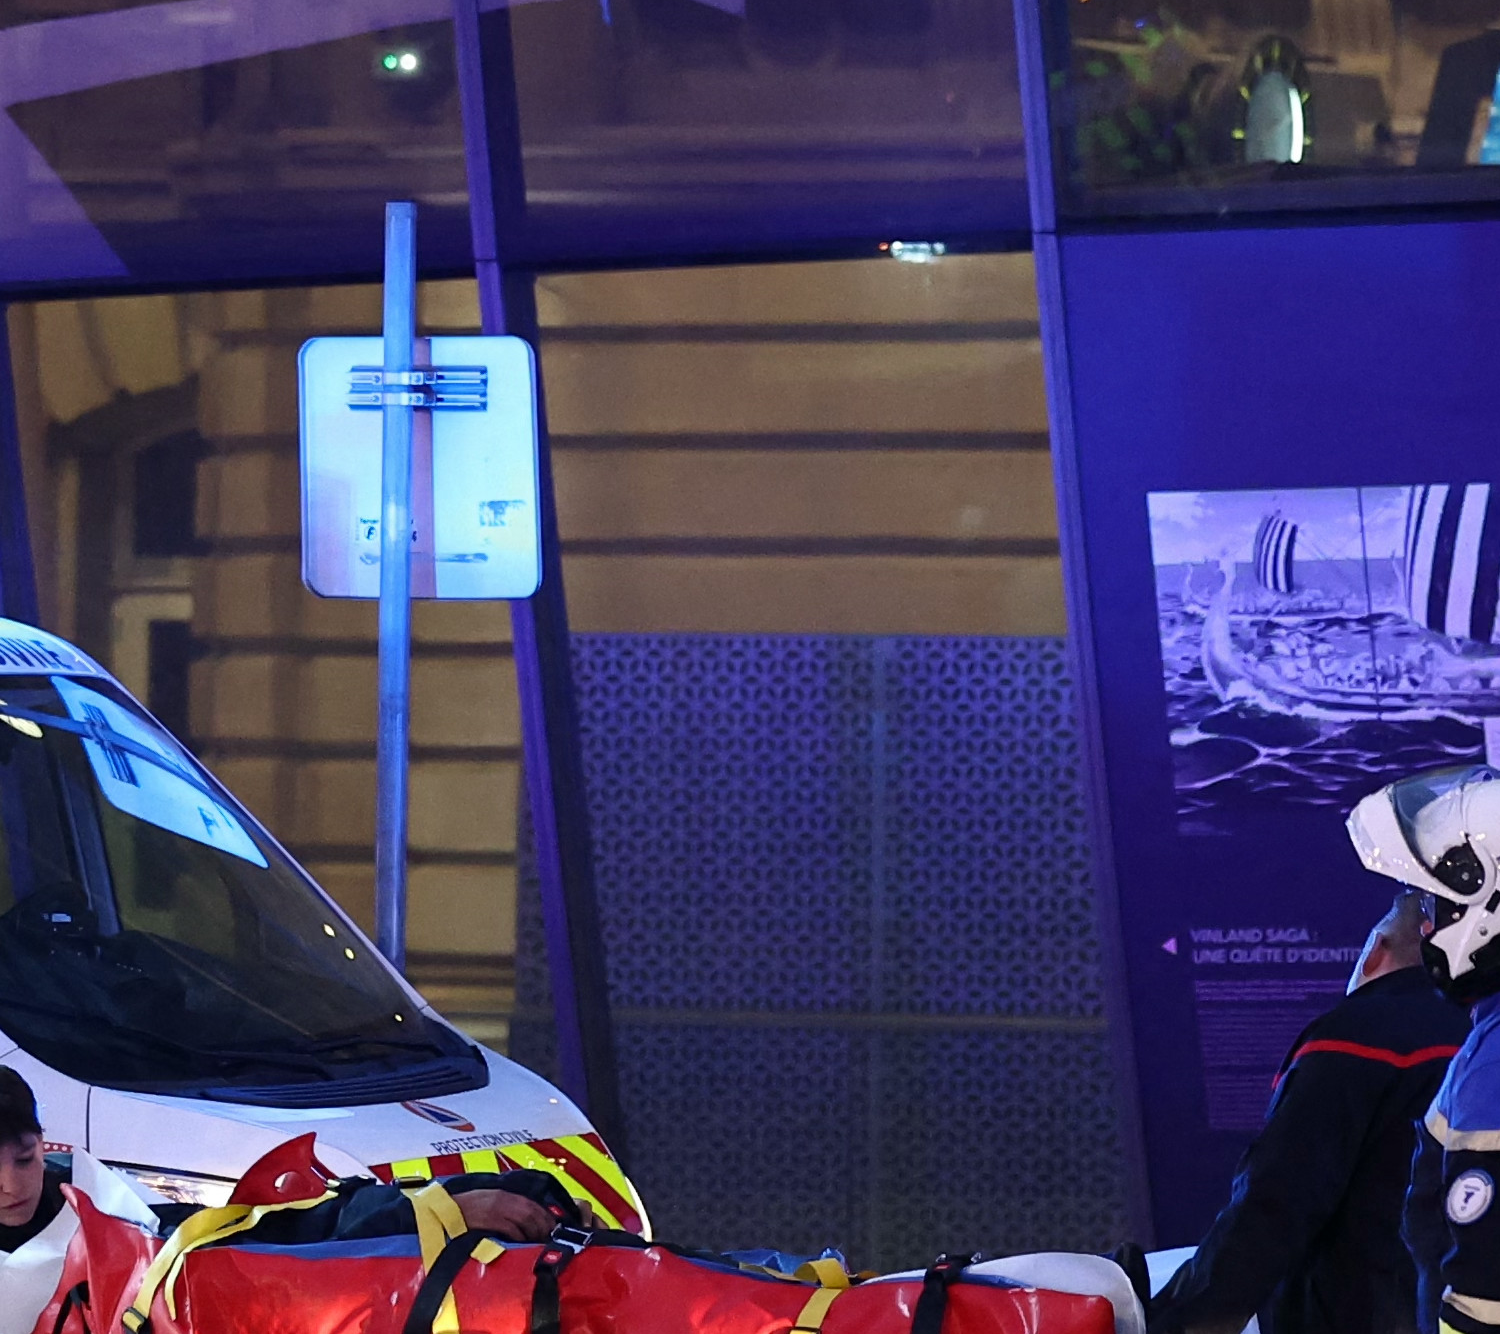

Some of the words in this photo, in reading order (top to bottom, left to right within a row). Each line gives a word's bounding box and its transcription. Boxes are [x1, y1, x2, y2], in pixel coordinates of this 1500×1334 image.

[1190, 929, 1263, 943] VINLAND
[1265, 928, 1311, 943] SAGA
[1193, 948, 1227, 964] UNE
[1229, 944, 1284, 964] QUÊTE
[431, 1133, 501, 1155] PROTECTION
[500, 1129, 536, 1145] CIVILE
